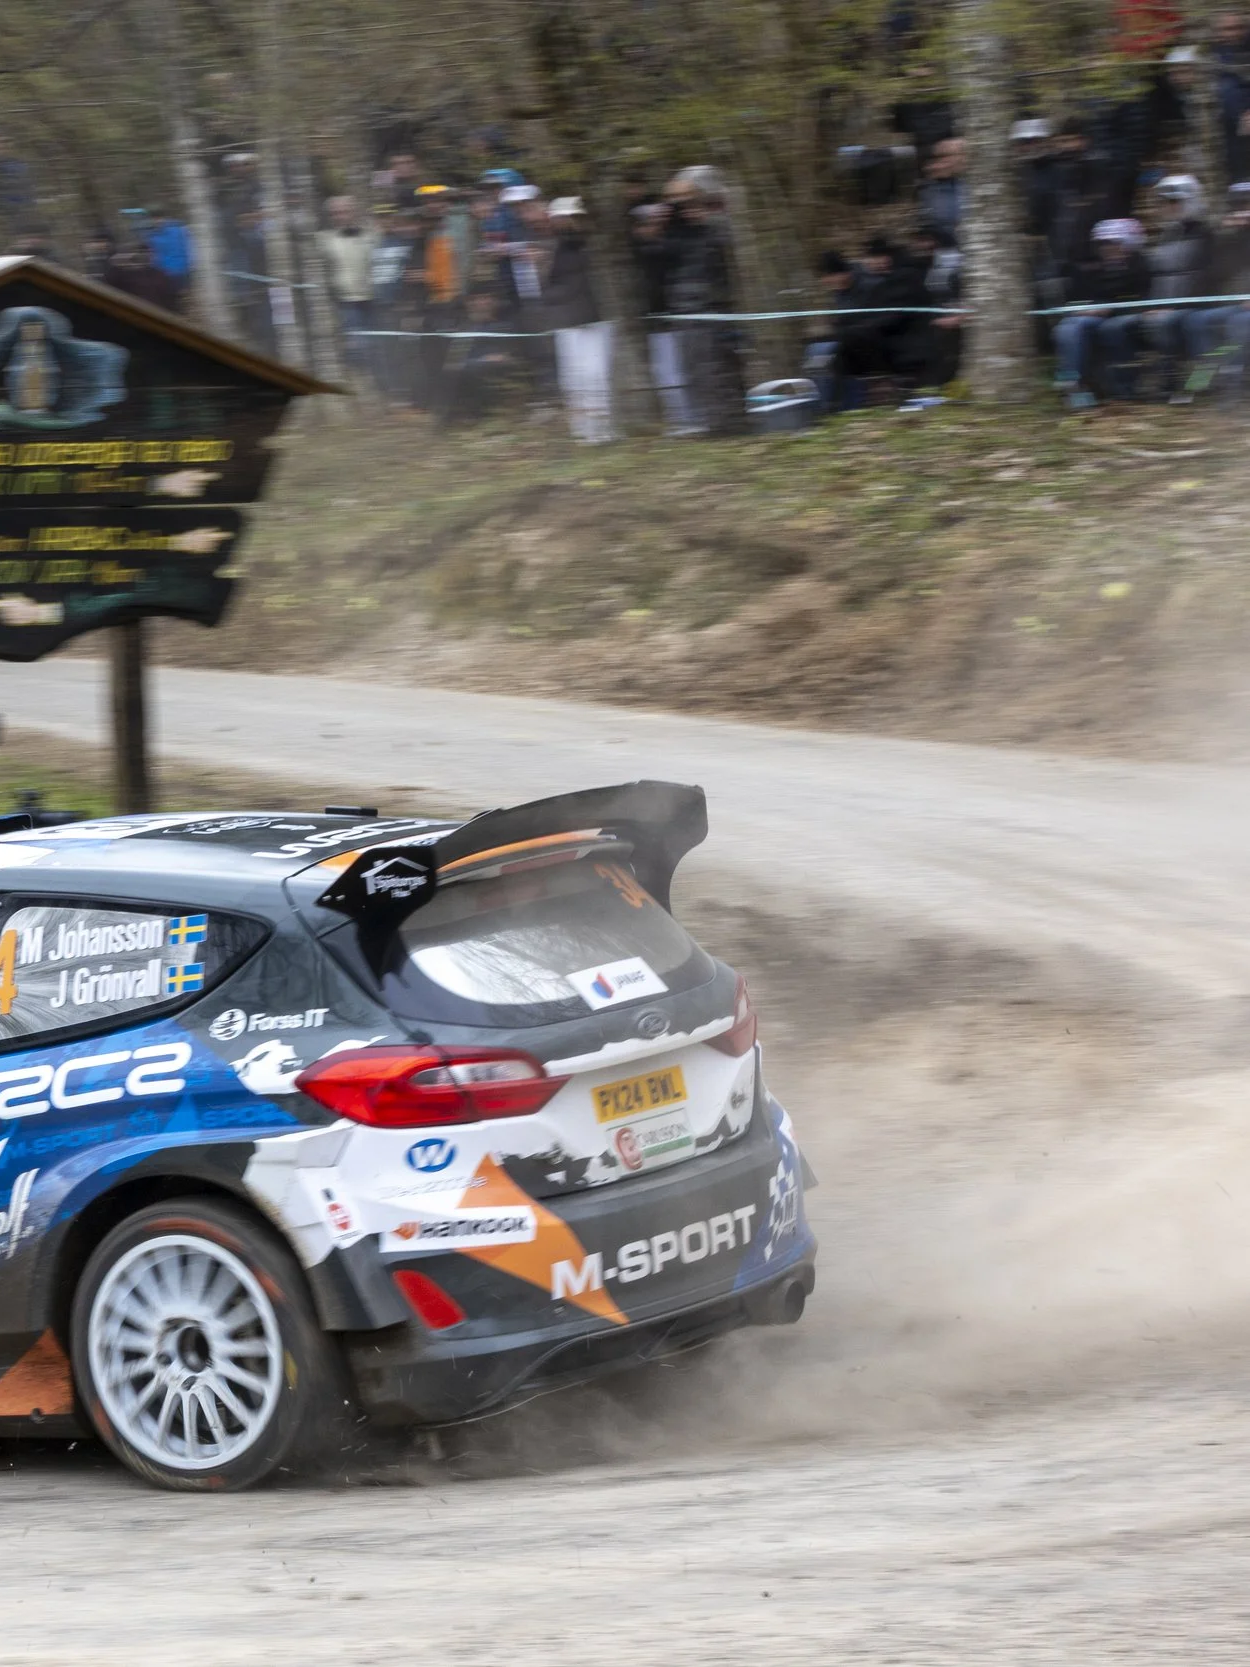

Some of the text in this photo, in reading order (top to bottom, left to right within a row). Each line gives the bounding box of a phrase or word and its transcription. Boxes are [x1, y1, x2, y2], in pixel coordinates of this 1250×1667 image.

[19, 919, 165, 965] M Johansson
[50, 958, 163, 1009] J Grönvall
[549, 1203, 757, 1300] M-SPORT
